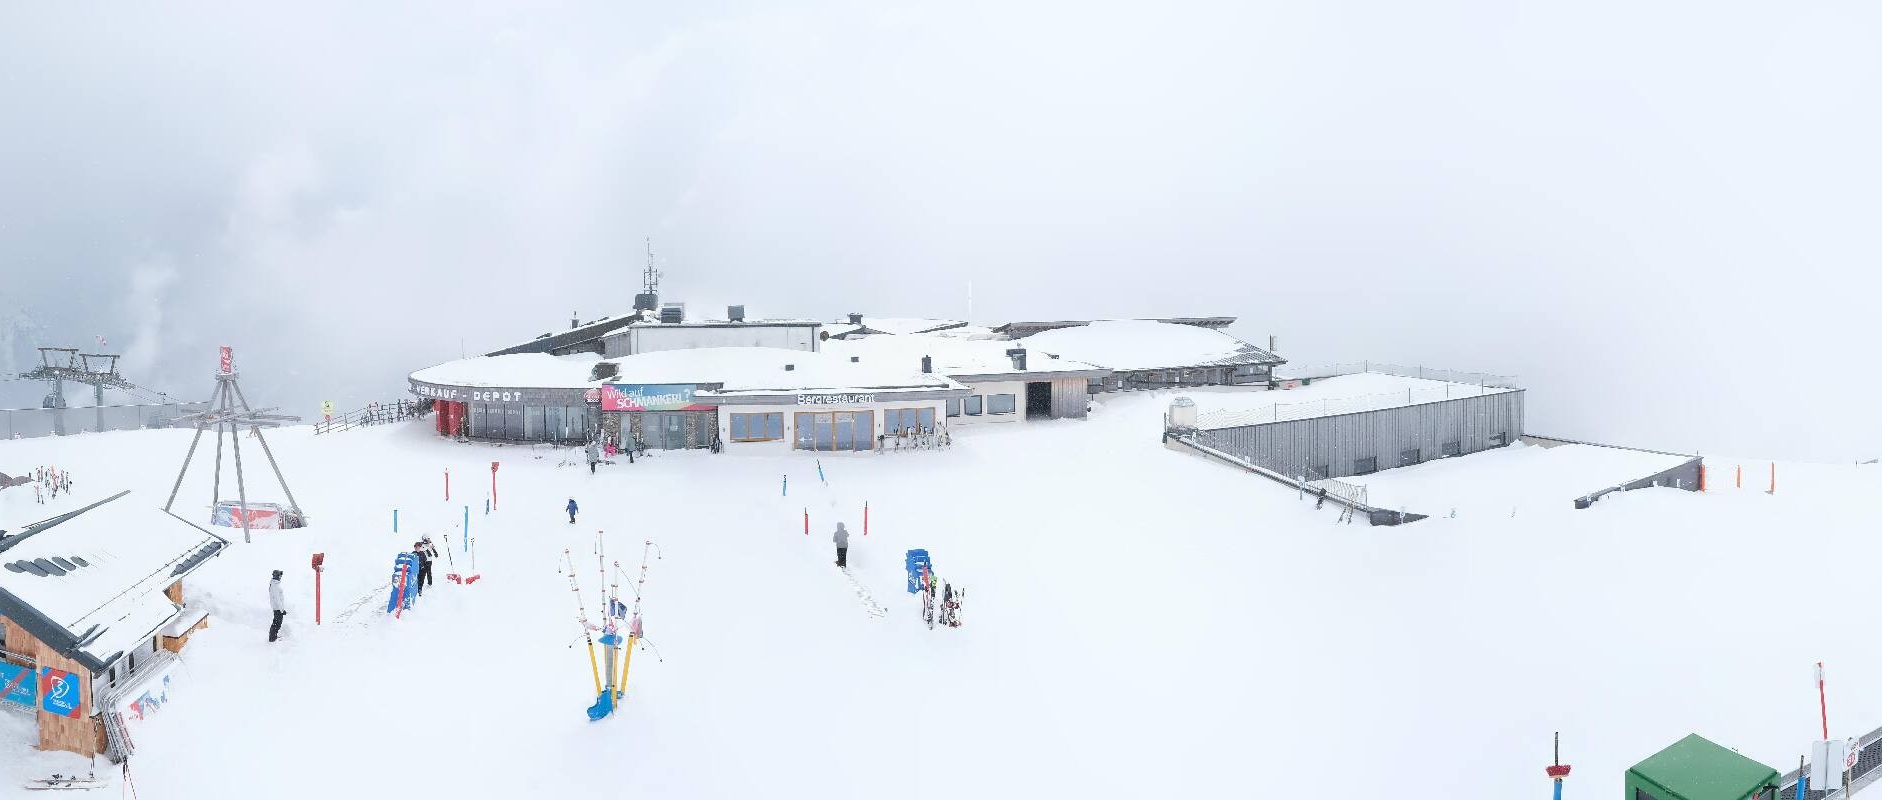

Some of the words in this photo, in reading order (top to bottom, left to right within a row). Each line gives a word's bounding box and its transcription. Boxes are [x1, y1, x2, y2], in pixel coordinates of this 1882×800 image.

[416, 385, 457, 399] VERKAUF
[473, 391, 522, 402] DEPOT
[607, 387, 627, 399] Wild
[629, 386, 644, 398] auf
[797, 394, 875, 405] Bergrestaurant
